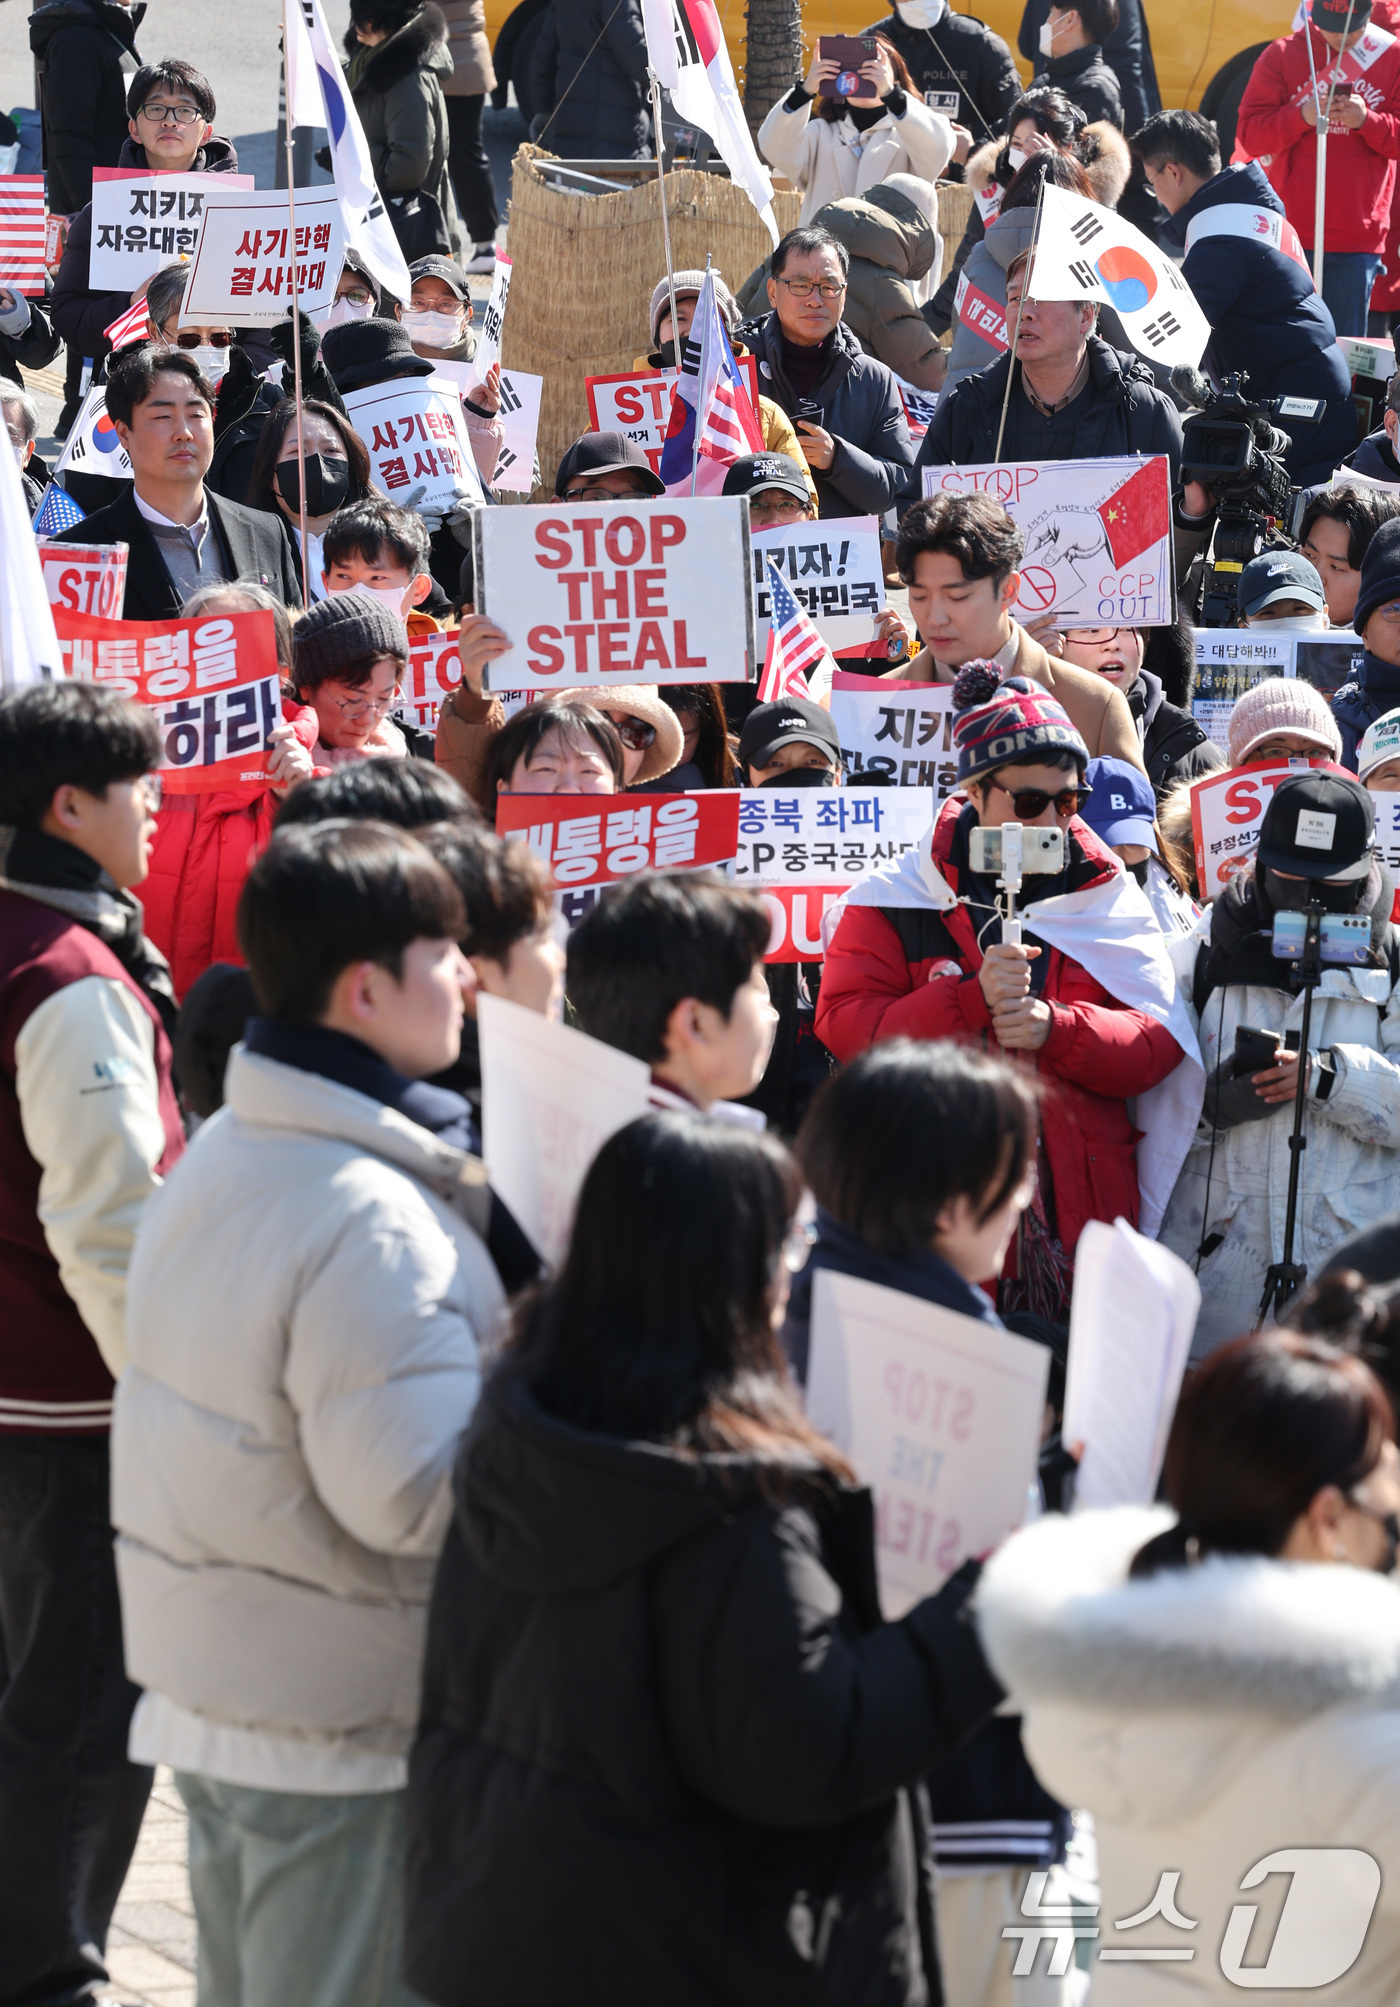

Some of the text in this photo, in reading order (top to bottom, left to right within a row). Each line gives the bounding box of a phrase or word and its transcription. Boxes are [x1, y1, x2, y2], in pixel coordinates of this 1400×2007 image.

[923, 70, 968, 80] POLICE
[1354, 77, 1386, 111] orth
[235, 222, 332, 259] 사기탄핵
[230, 261, 327, 296] 결사반대
[614, 380, 678, 424] ST
[371, 412, 458, 453] 사기탄핵
[624, 430, 649, 443] 선거
[378, 447, 463, 491] 결사반대
[753, 459, 782, 468] STOP
[753, 469, 786, 478] STEAL
[534, 514, 687, 570] STOP
[1270, 563, 1288, 572] NIKE
[557, 568, 669, 621] THE
[1098, 573, 1155, 598] CCP
[1097, 595, 1153, 619] OUT
[527, 619, 707, 675] STEAL
[1212, 644, 1277, 658] 대답해봐!!
[778, 718, 807, 728] Jeep
[739, 796, 884, 834] 종북 좌파
[781, 841, 920, 873] 중국공산
